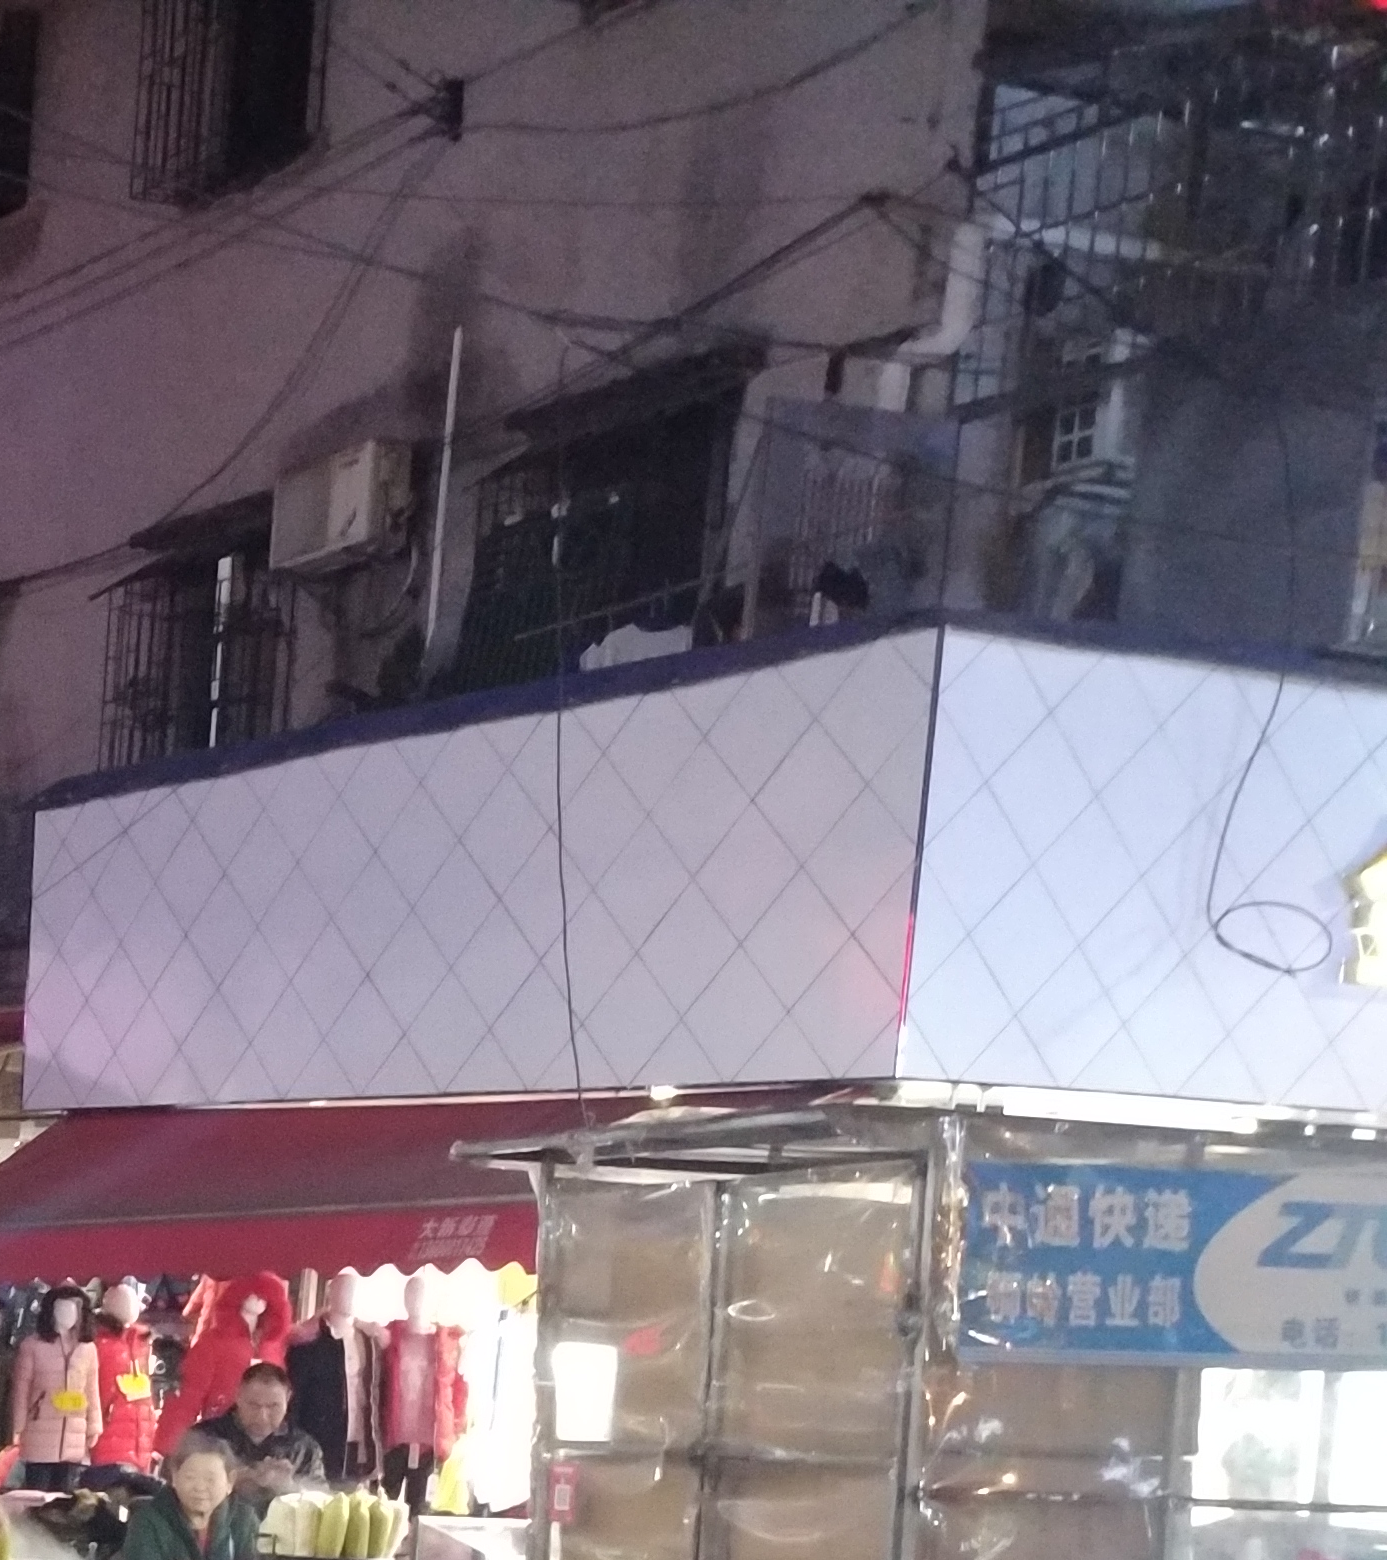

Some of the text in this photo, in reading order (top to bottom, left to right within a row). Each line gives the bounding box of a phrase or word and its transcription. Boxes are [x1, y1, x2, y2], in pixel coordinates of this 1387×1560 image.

[981, 1183, 1192, 1253] 中通快递
[1257, 1202, 1387, 1271] ZT
